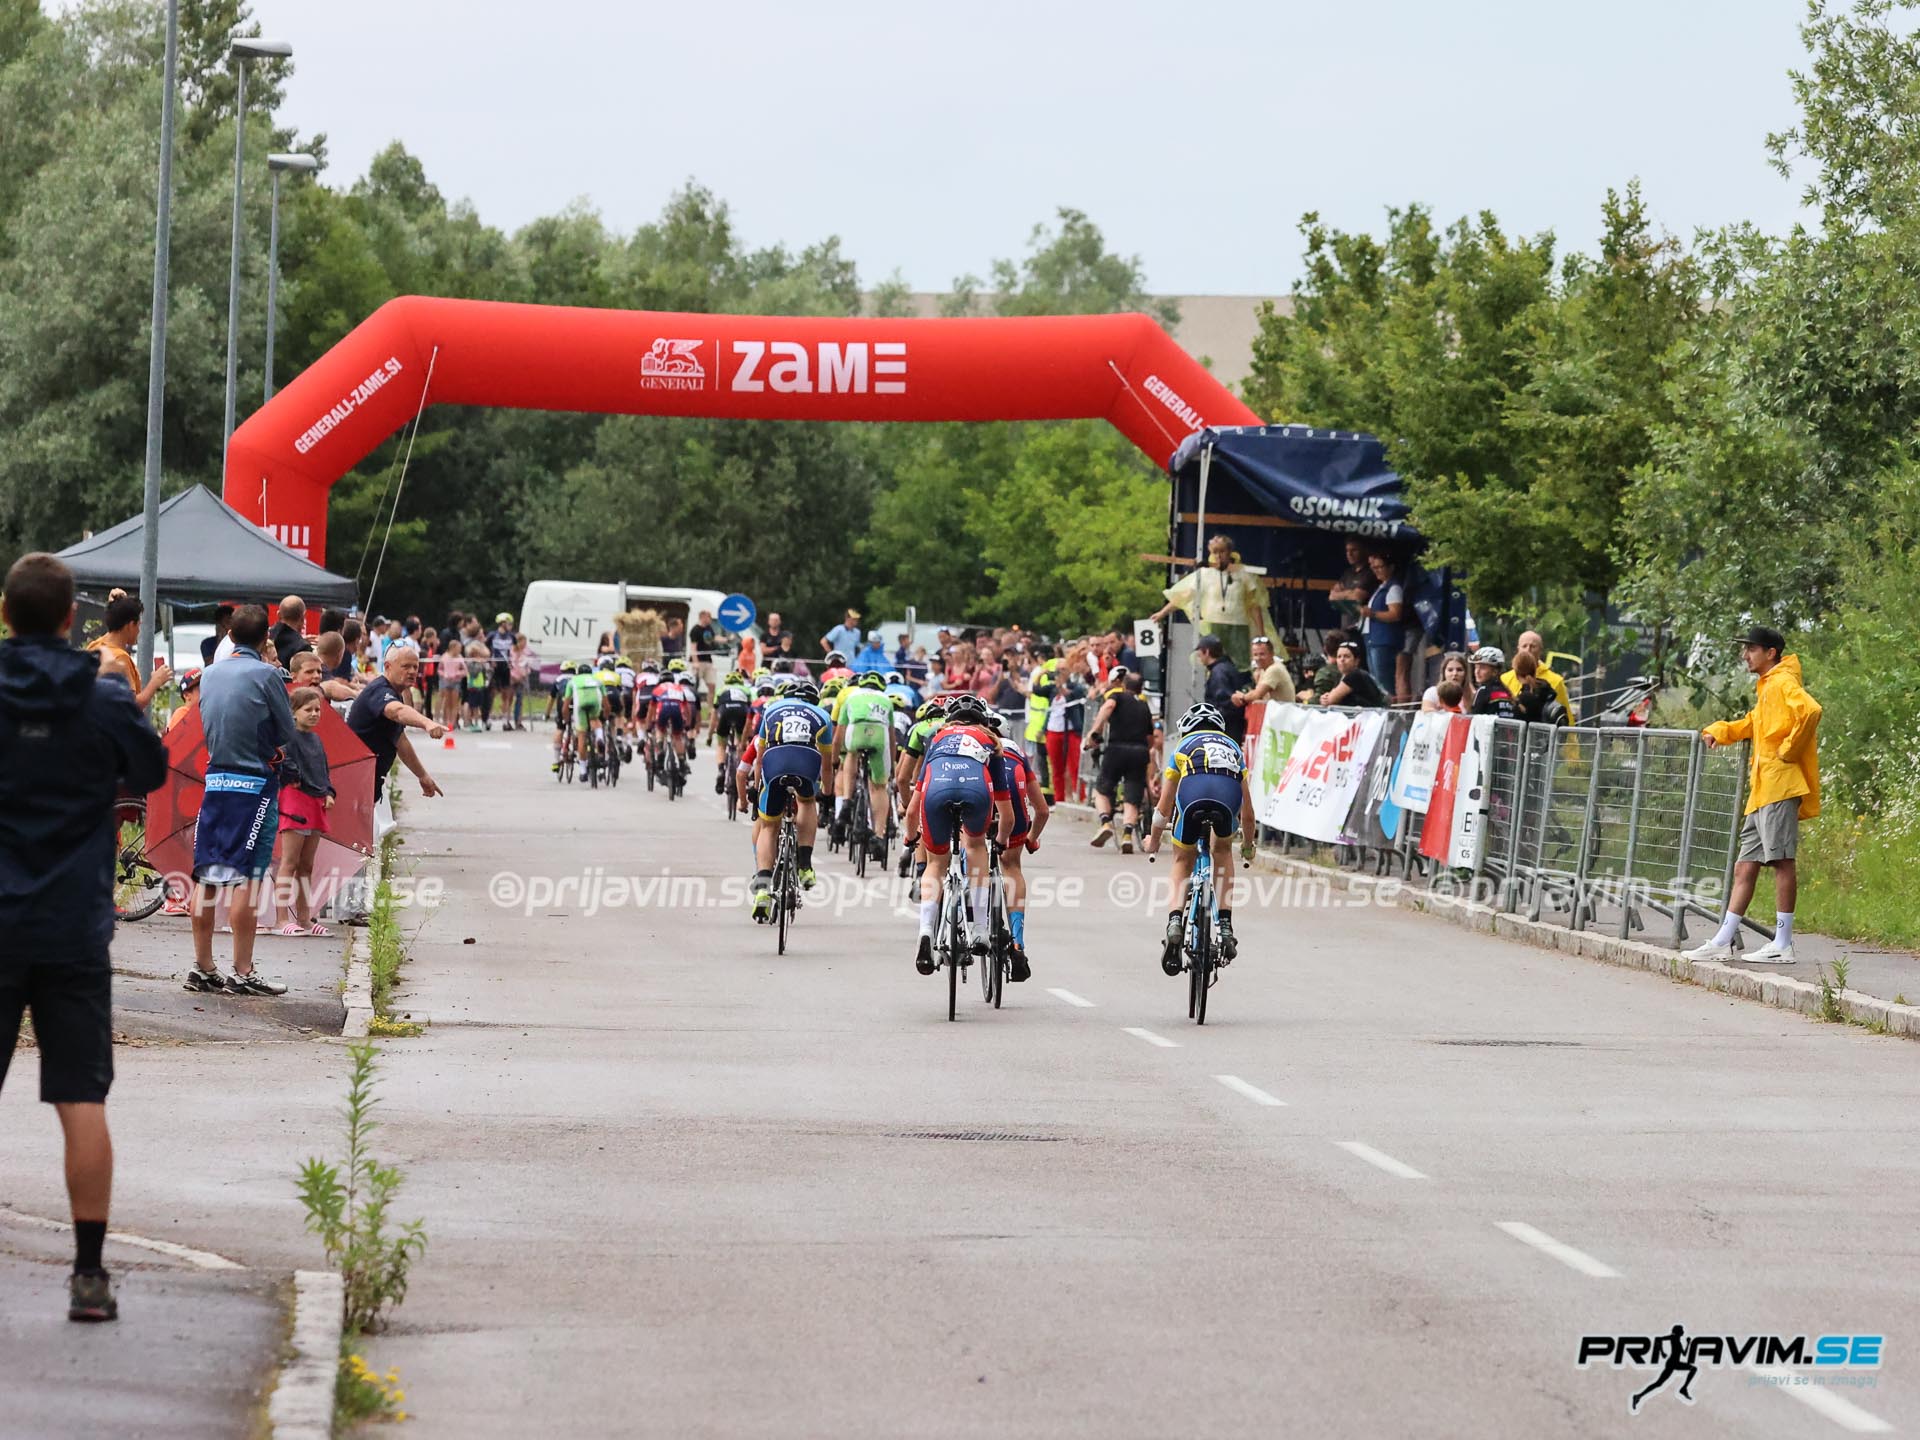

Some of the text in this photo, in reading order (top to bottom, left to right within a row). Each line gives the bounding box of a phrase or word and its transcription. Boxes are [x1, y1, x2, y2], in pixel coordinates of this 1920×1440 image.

[639, 378, 704, 391] GENERALI
[1143, 374, 1205, 432] GENERALI-
[294, 356, 403, 455] GENERALI-ZAME.SI
[1140, 629, 1154, 646] 8
